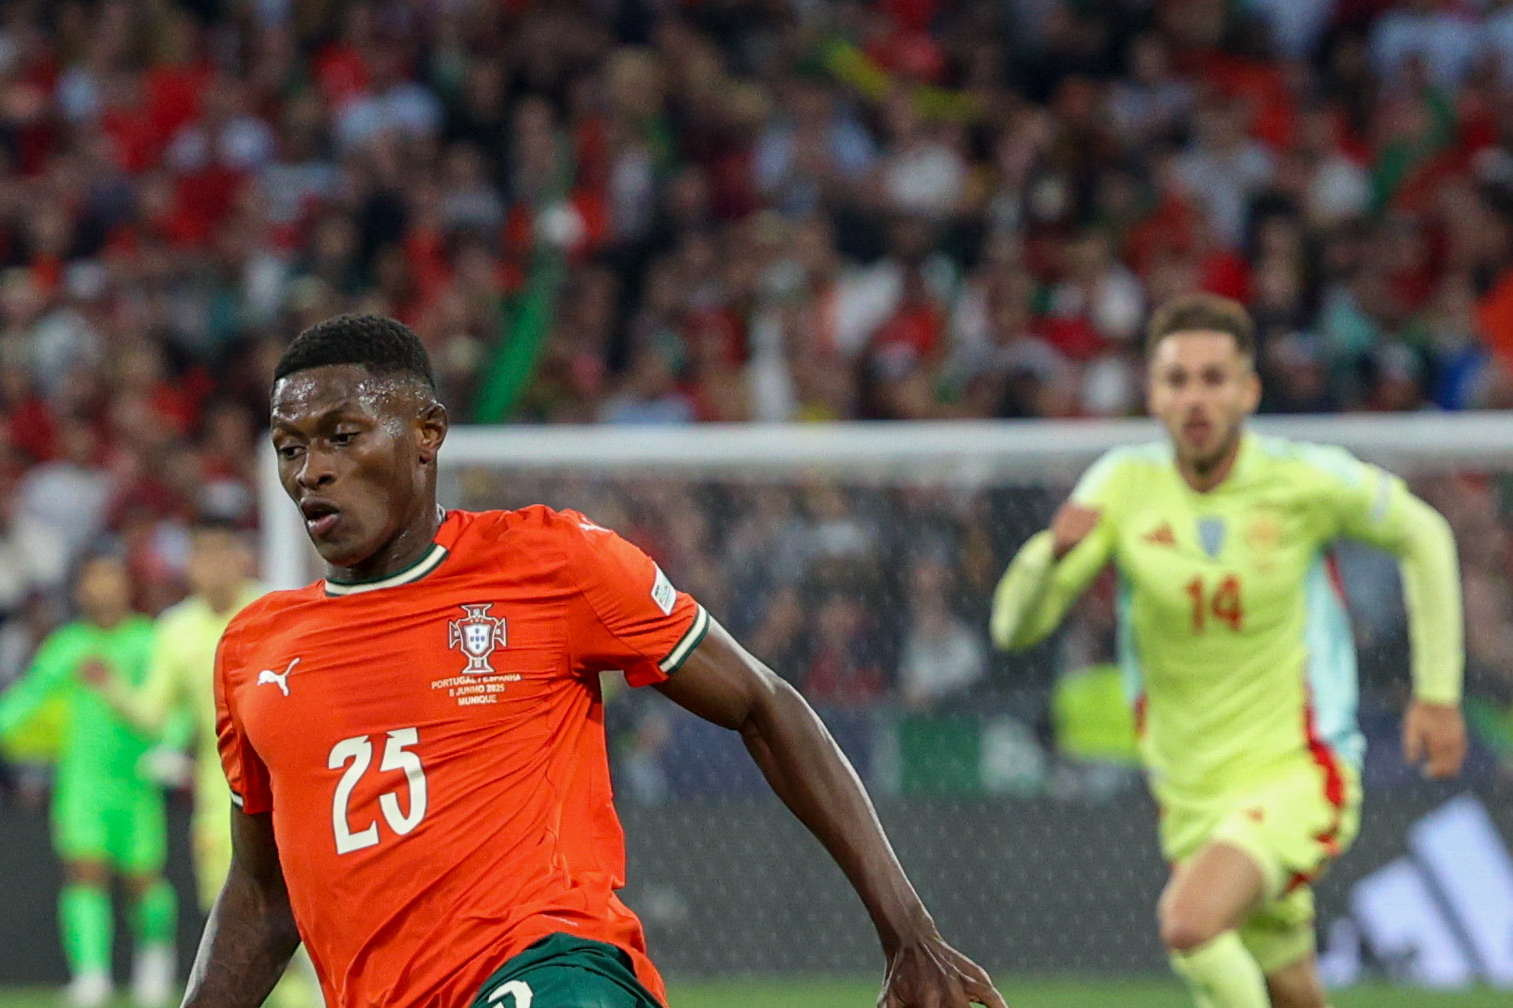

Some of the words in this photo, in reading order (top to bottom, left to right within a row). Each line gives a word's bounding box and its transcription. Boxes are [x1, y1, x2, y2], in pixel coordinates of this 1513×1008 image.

[1185, 573, 1242, 635] 14
[431, 676, 476, 689] PORTUGAL
[456, 684, 485, 696] JUNHO
[486, 684, 505, 692] 2025
[458, 695, 497, 705] MUNIQUE
[328, 726, 427, 855] 25
